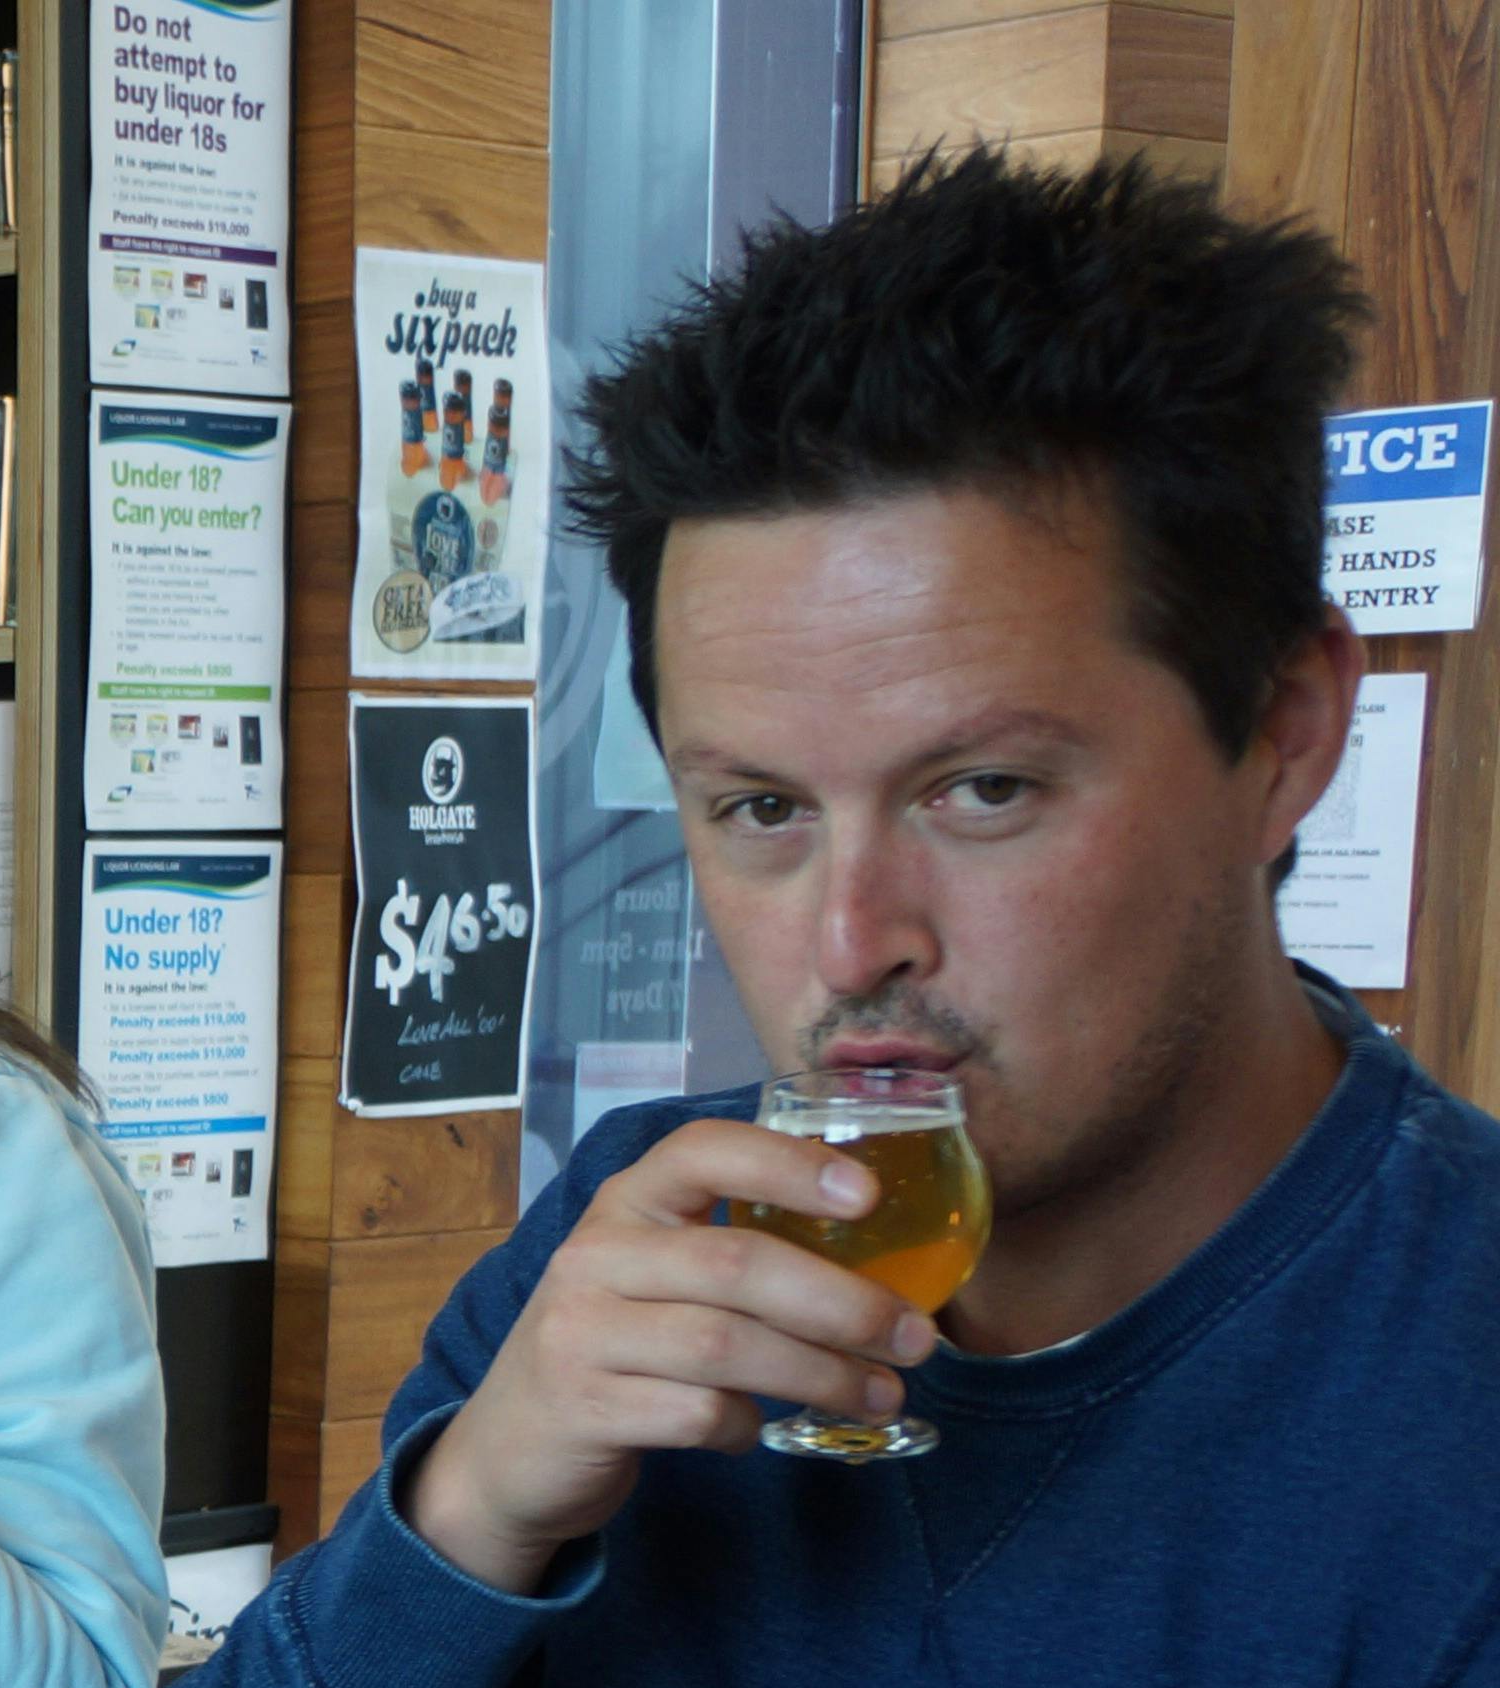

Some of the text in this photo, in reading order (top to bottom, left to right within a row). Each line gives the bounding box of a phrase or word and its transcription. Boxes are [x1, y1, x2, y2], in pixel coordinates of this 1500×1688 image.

[114, 6, 192, 42] Do not
[114, 43, 238, 83] attempt to
[114, 76, 266, 121] buy liquor for
[114, 118, 228, 153] under 18s
[139, 159, 177, 174] against
[113, 209, 159, 229] Penalty
[161, 215, 206, 233] exceeds
[426, 277, 478, 318] buy a
[111, 460, 223, 493] Under 18?
[112, 497, 262, 533] Can you enter?
[136, 545, 171, 557] against
[1339, 548, 1437, 572] HANDS
[1343, 585, 1440, 608] ENTRY
[382, 603, 425, 622] FREE
[116, 662, 157, 678] Penalty
[409, 805, 477, 830] HOLGATE
[104, 908, 223, 935] Under 18?
[374, 878, 529, 1006] $46.50
[104, 944, 140, 971] No
[115, 982, 125, 993] is
[128, 981, 168, 996] against
[171, 982, 186, 993] the
[110, 1015, 154, 1028] Penalty
[158, 1014, 200, 1027] exceeds
[109, 1050, 153, 1064] Penalty
[157, 1049, 200, 1062] exceeds
[109, 1097, 153, 1112] Penalty
[156, 1094, 200, 1108] exceeds
